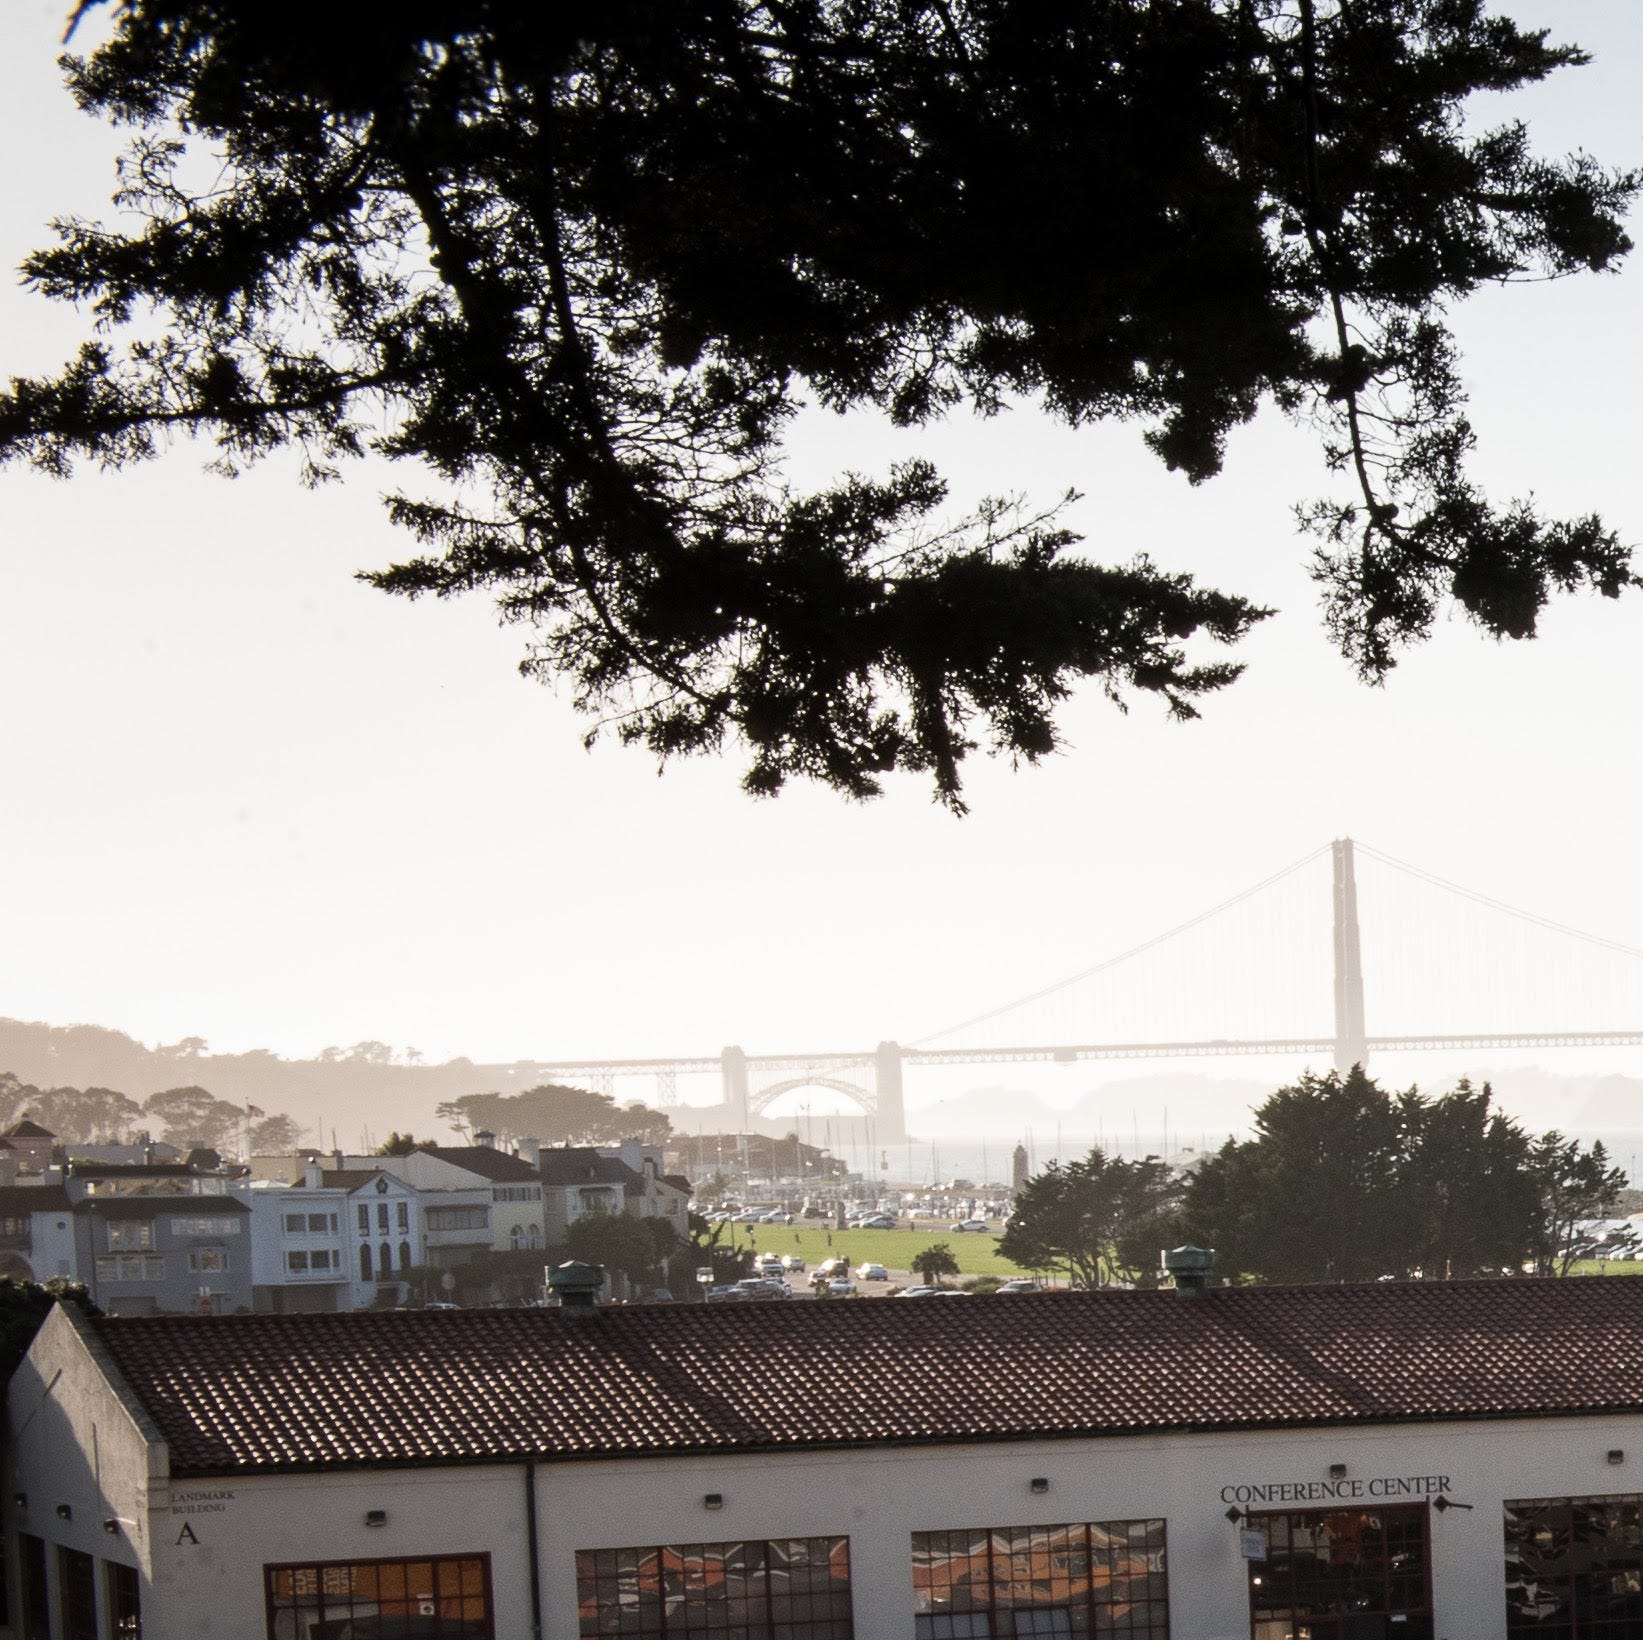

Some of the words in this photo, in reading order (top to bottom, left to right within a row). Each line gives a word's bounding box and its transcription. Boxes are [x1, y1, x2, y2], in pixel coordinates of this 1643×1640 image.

[172, 1491, 236, 1502] LANDMARK
[1220, 1480, 1364, 1504] CONFERENCE
[1368, 1475, 1452, 1496] CENTER
[173, 1504, 226, 1514] BUILDING
[175, 1521, 200, 1546] A
